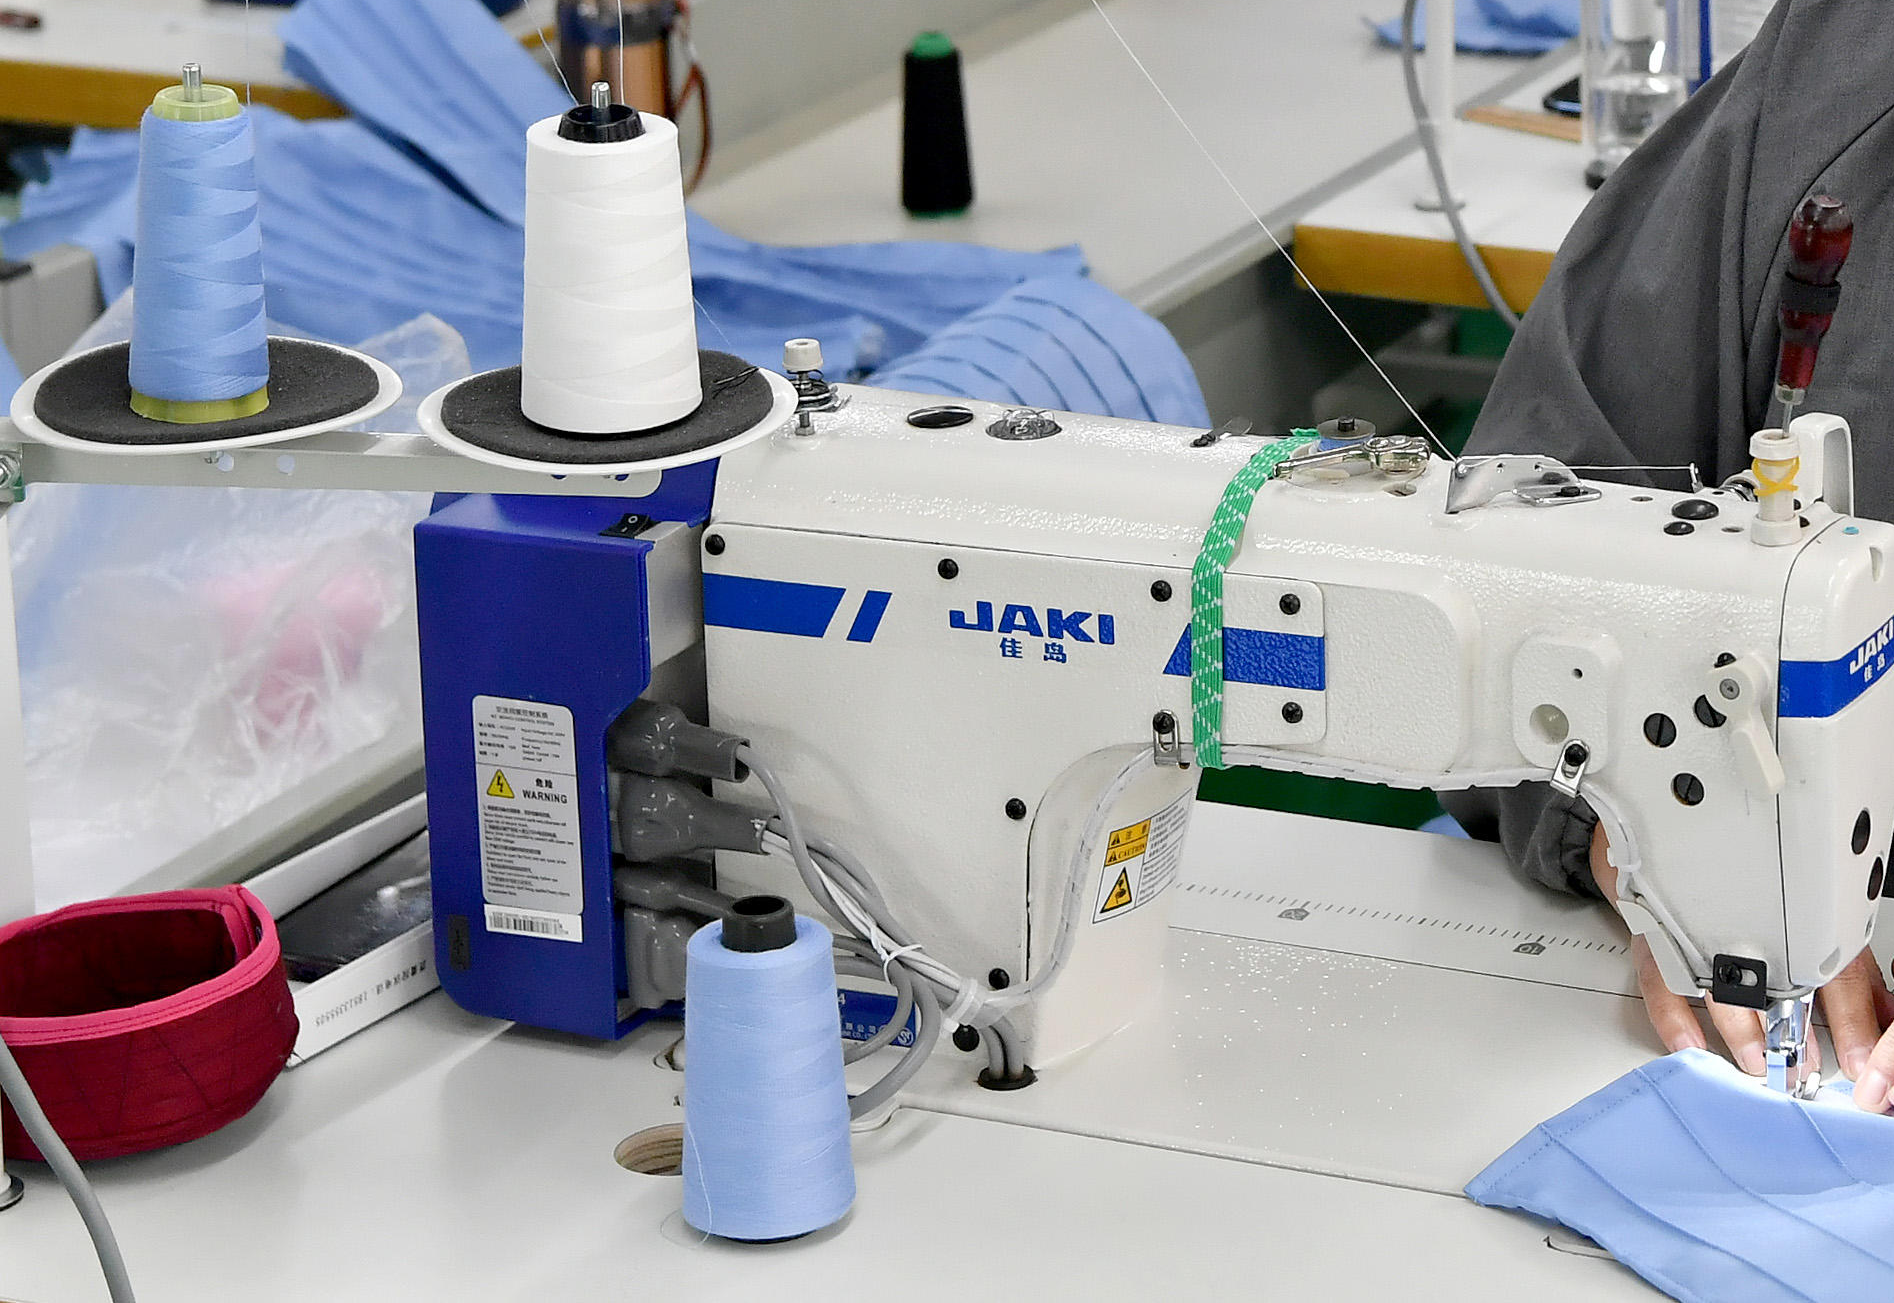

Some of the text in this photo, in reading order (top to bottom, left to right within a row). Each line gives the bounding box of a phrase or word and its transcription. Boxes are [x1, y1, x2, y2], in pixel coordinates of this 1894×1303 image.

[949, 600, 1115, 646] JAKI
[1849, 618, 1894, 676] JAKI
[522, 789, 568, 804] WARNING
